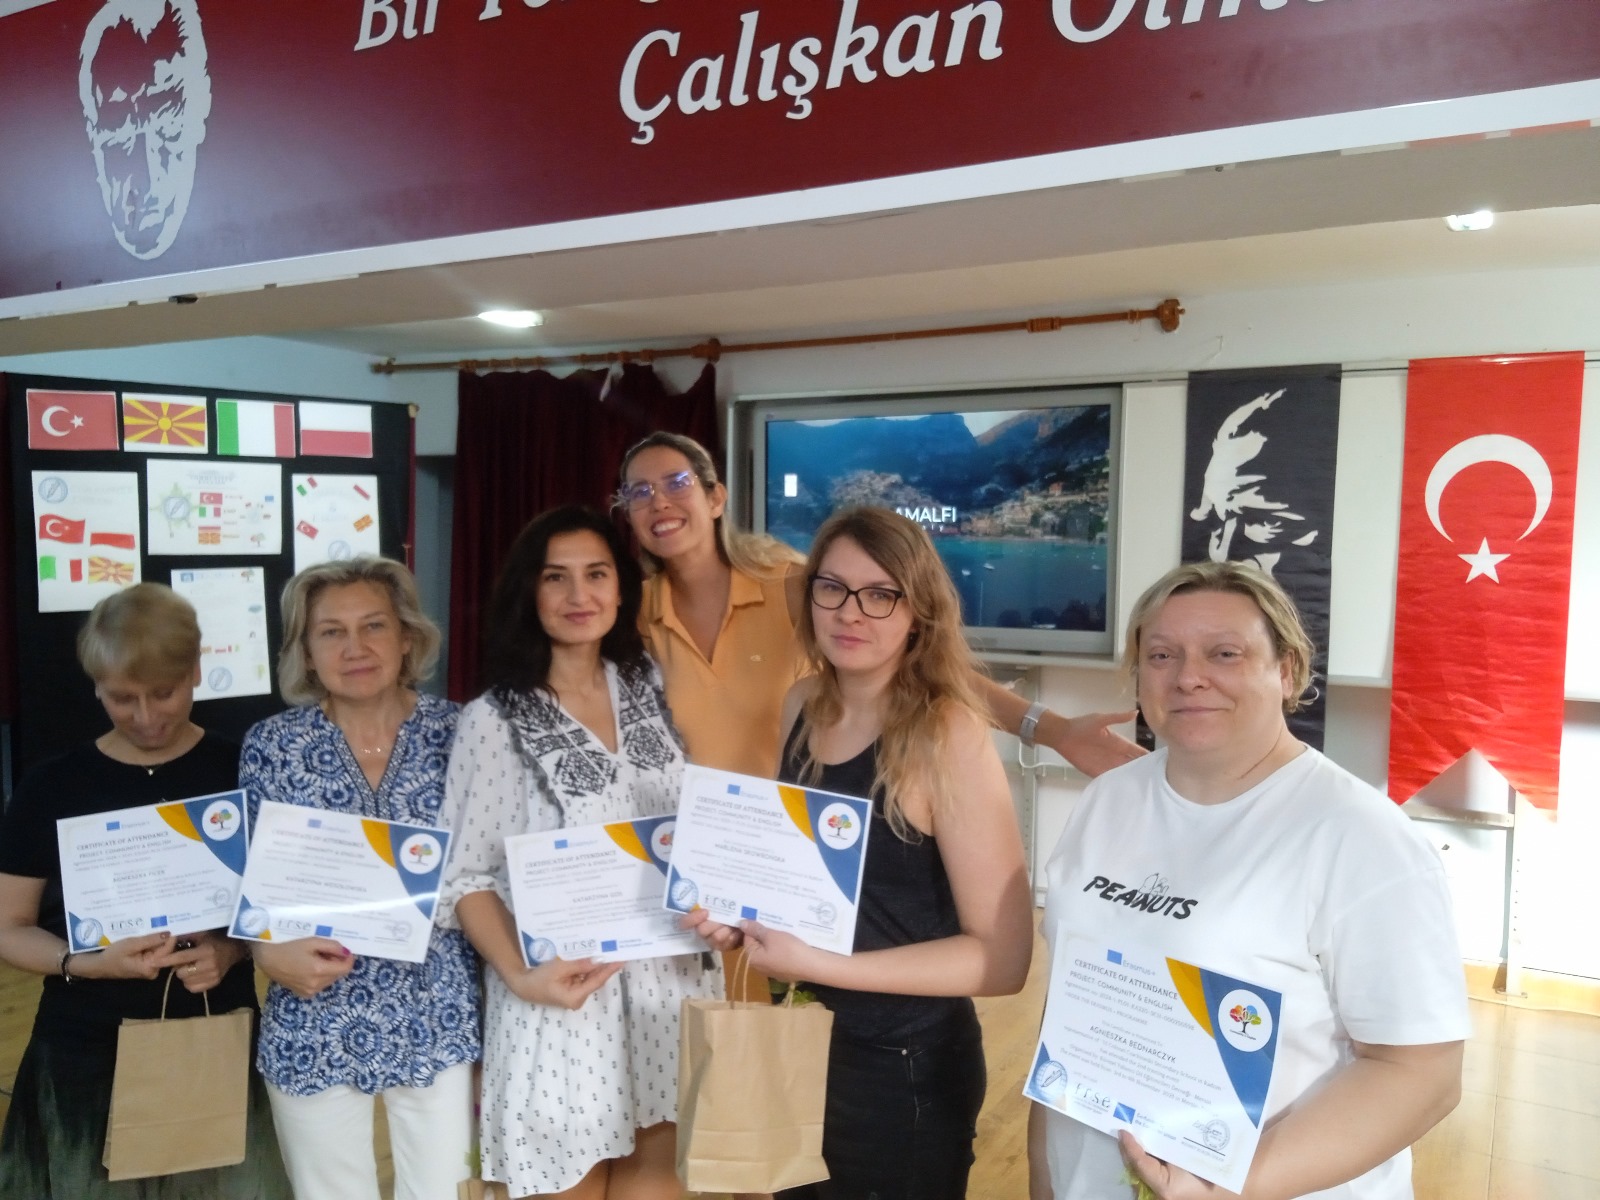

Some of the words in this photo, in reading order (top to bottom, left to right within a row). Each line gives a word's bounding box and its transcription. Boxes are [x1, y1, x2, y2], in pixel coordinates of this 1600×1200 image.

[619, 0, 1003, 145] Çalışkan
[1083, 875, 1199, 920] PEANUTS
[1074, 958, 1117, 979] CERTIFICATE
[1117, 973, 1128, 983] OF
[1129, 977, 1178, 1000] ATTENDANCE
[1097, 980, 1136, 999] COMMUNITY
[1144, 996, 1173, 1012] ENGLISH
[1090, 1024, 1127, 1045] AGNIESZKA
[1129, 1039, 1176, 1064] BEDNARCZYK
